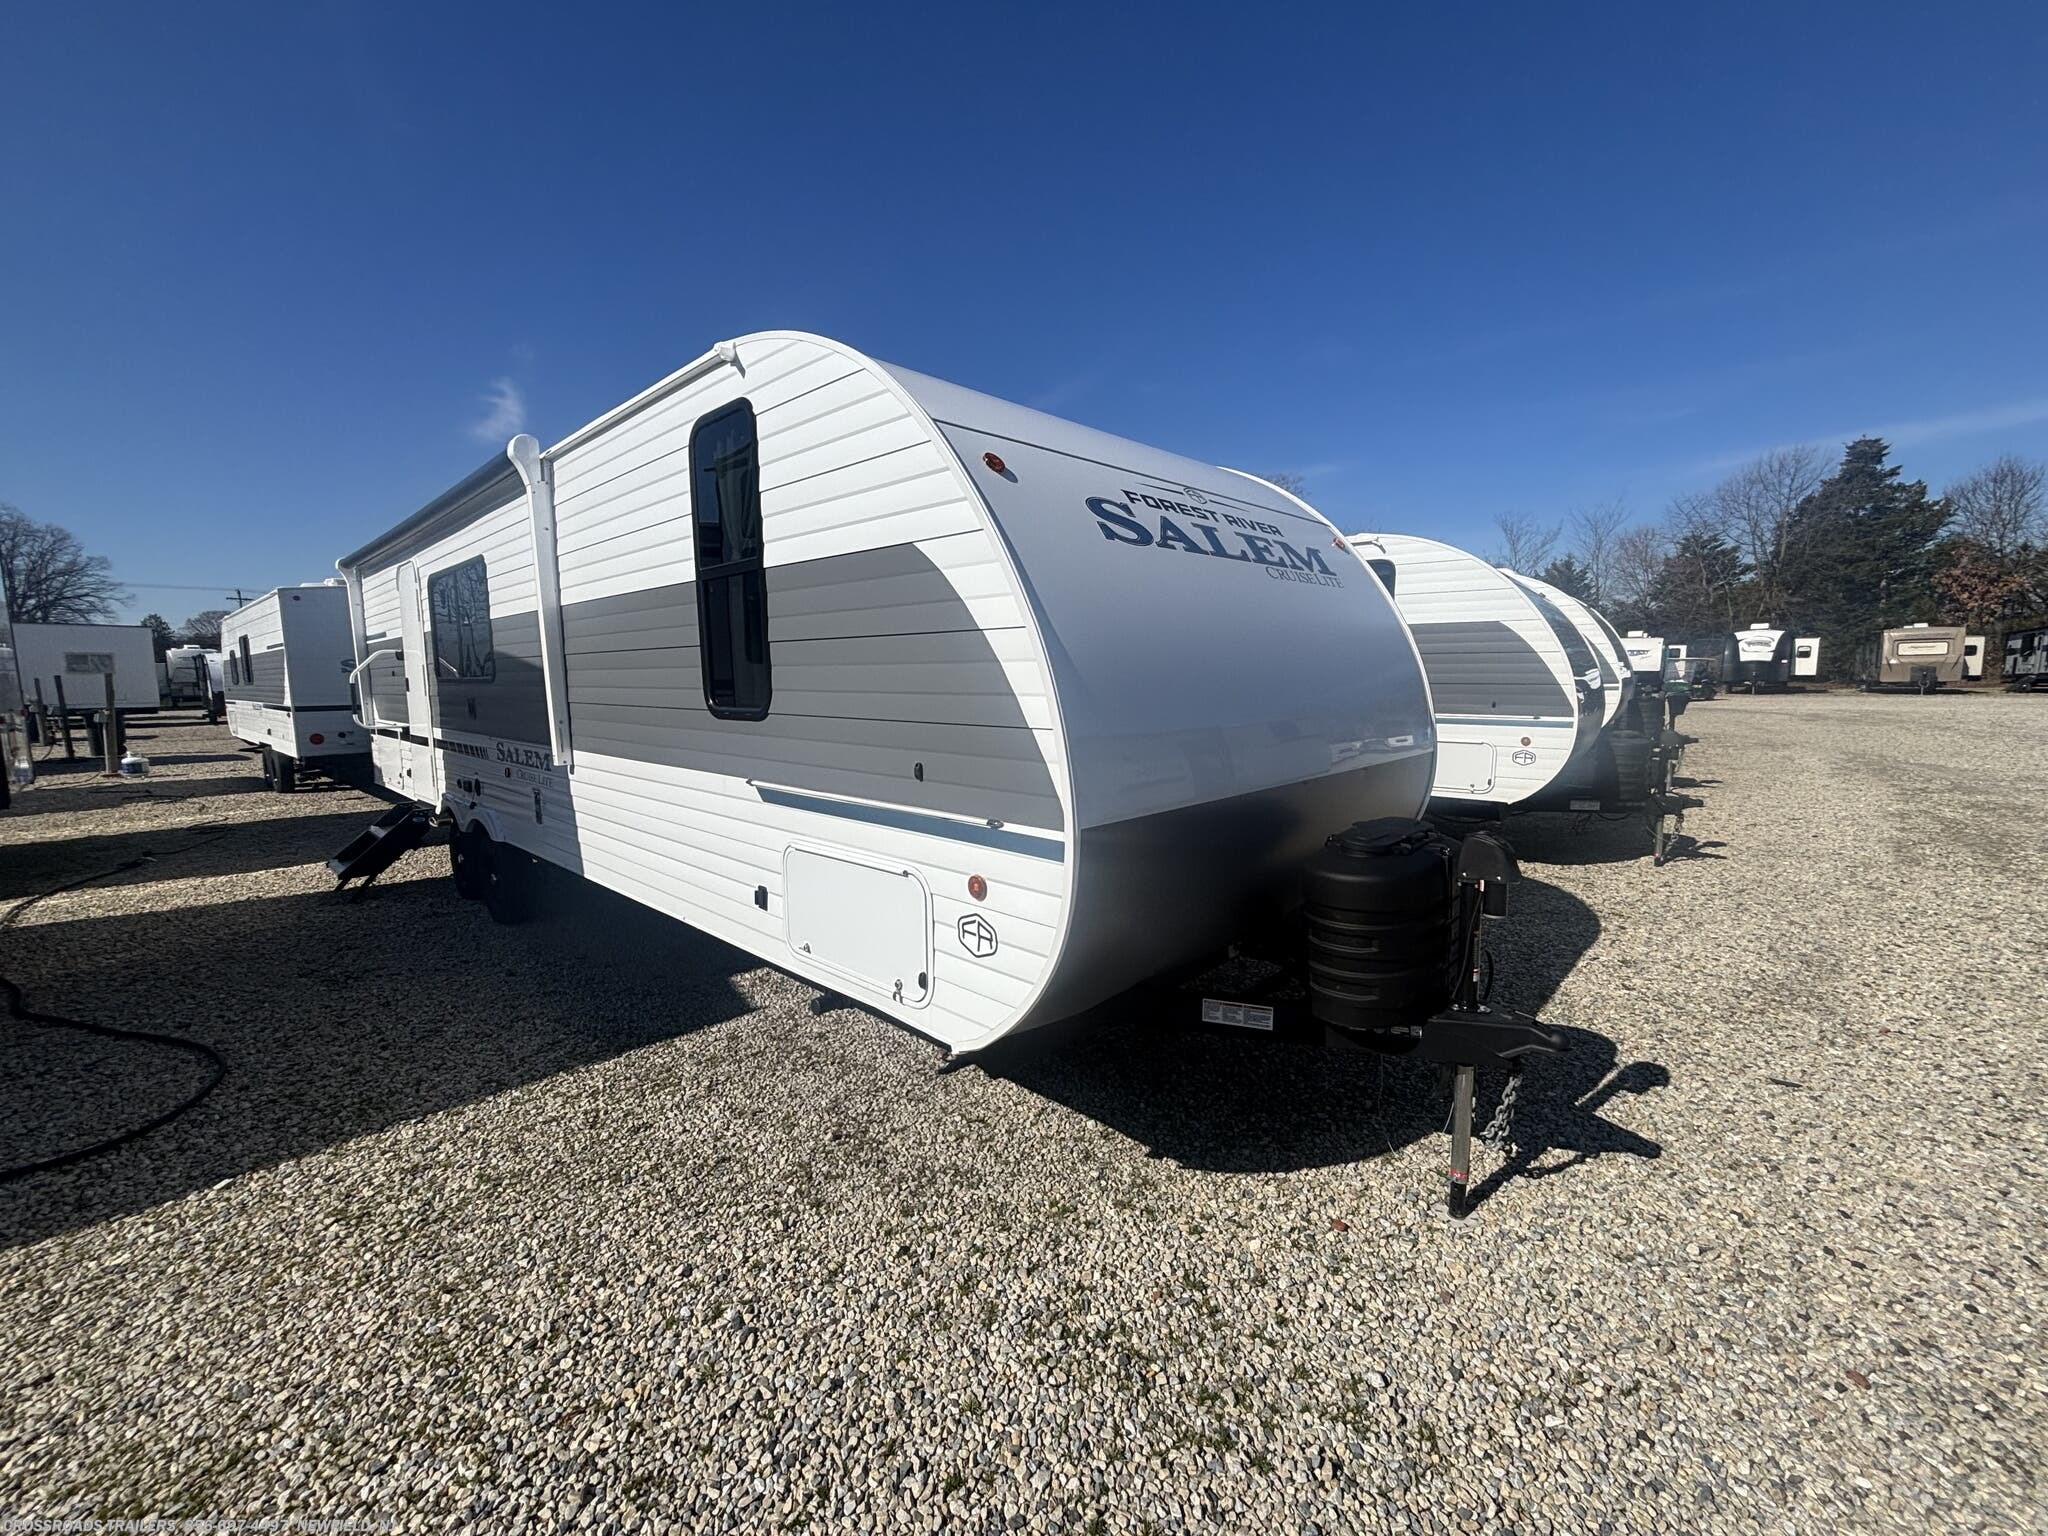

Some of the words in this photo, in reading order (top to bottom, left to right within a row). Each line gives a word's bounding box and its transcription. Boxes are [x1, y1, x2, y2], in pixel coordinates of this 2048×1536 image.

[1085, 496, 1337, 577] SALEM
[1121, 489, 1218, 522] FOREST
[1224, 513, 1284, 537] RIVER
[496, 741, 551, 772] SALEM
